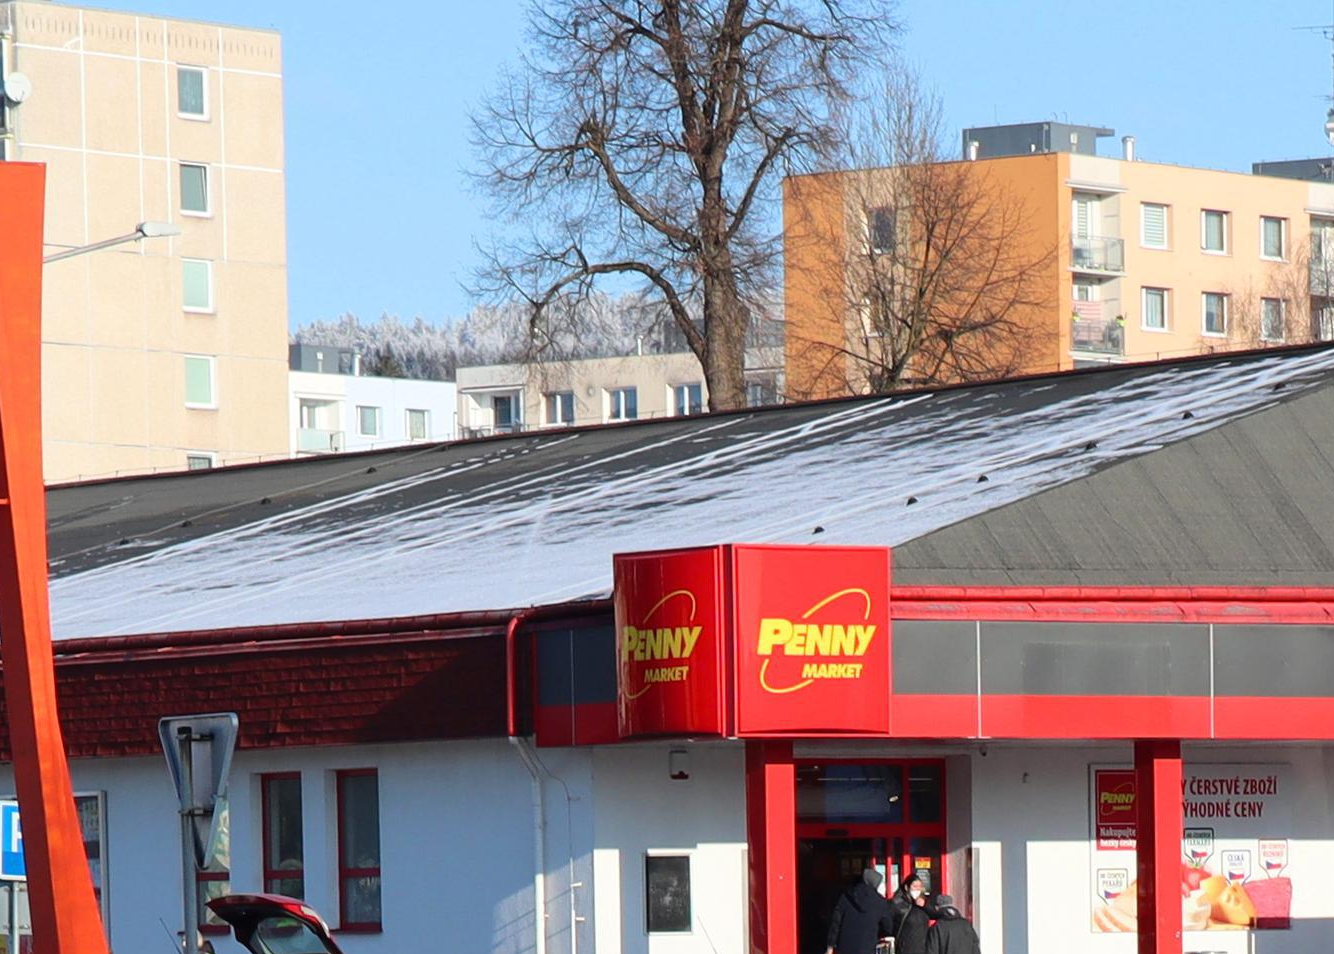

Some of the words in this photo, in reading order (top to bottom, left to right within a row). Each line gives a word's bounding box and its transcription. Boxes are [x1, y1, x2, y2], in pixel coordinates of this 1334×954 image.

[623, 625, 702, 661] PENNY
[757, 618, 876, 656] PENNY
[644, 666, 689, 683] MARKET
[802, 664, 863, 679] MARKET
[1190, 776, 1240, 796] ČERSTVÉ
[1243, 776, 1277, 795] ZBOŽÍ
[1100, 792, 1136, 804] PENNY
[1182, 800, 1231, 818] ÝHODNÉ
[1234, 802, 1264, 818] CENY
